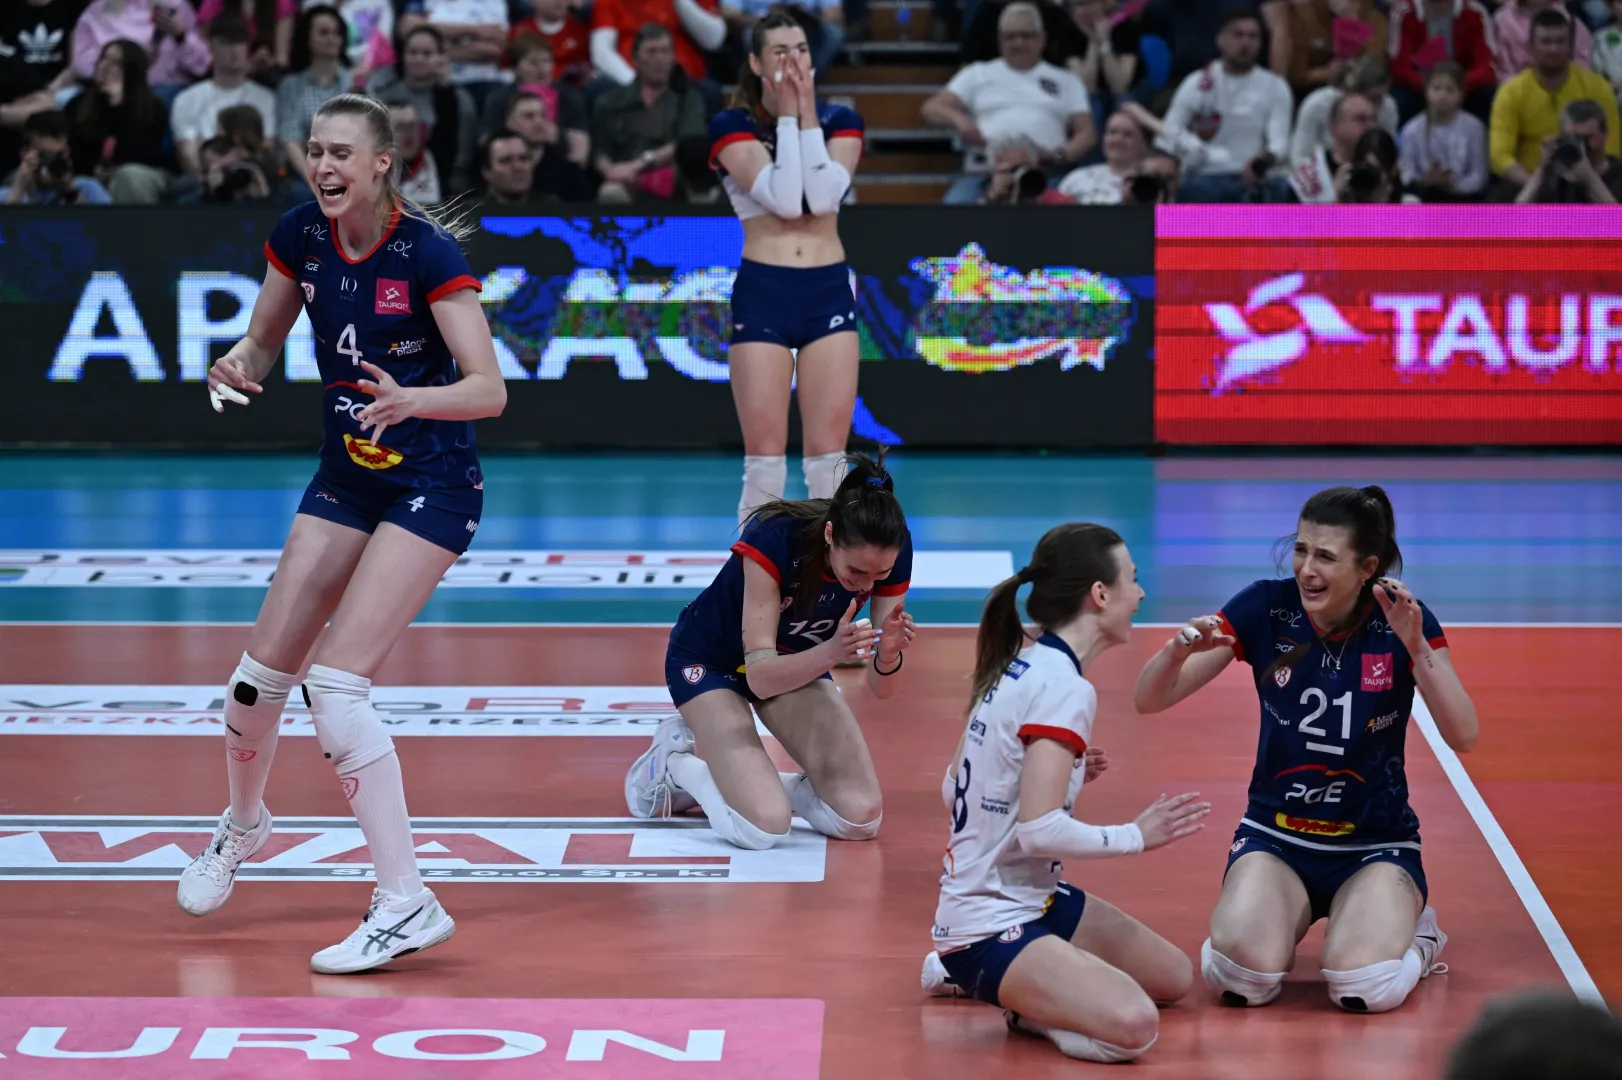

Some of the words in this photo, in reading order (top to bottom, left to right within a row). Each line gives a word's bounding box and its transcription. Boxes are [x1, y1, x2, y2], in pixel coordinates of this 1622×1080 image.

[336, 323, 363, 366] 4
[407, 496, 426, 513] 4
[788, 619, 834, 645] 12
[1298, 686, 1353, 740] 21
[1285, 781, 1346, 804] PGE
[470, 869, 560, 877] o.o.
[580, 868, 658, 878] Sp.
[678, 868, 722, 877] k.
[0, 1025, 725, 1061] URON
